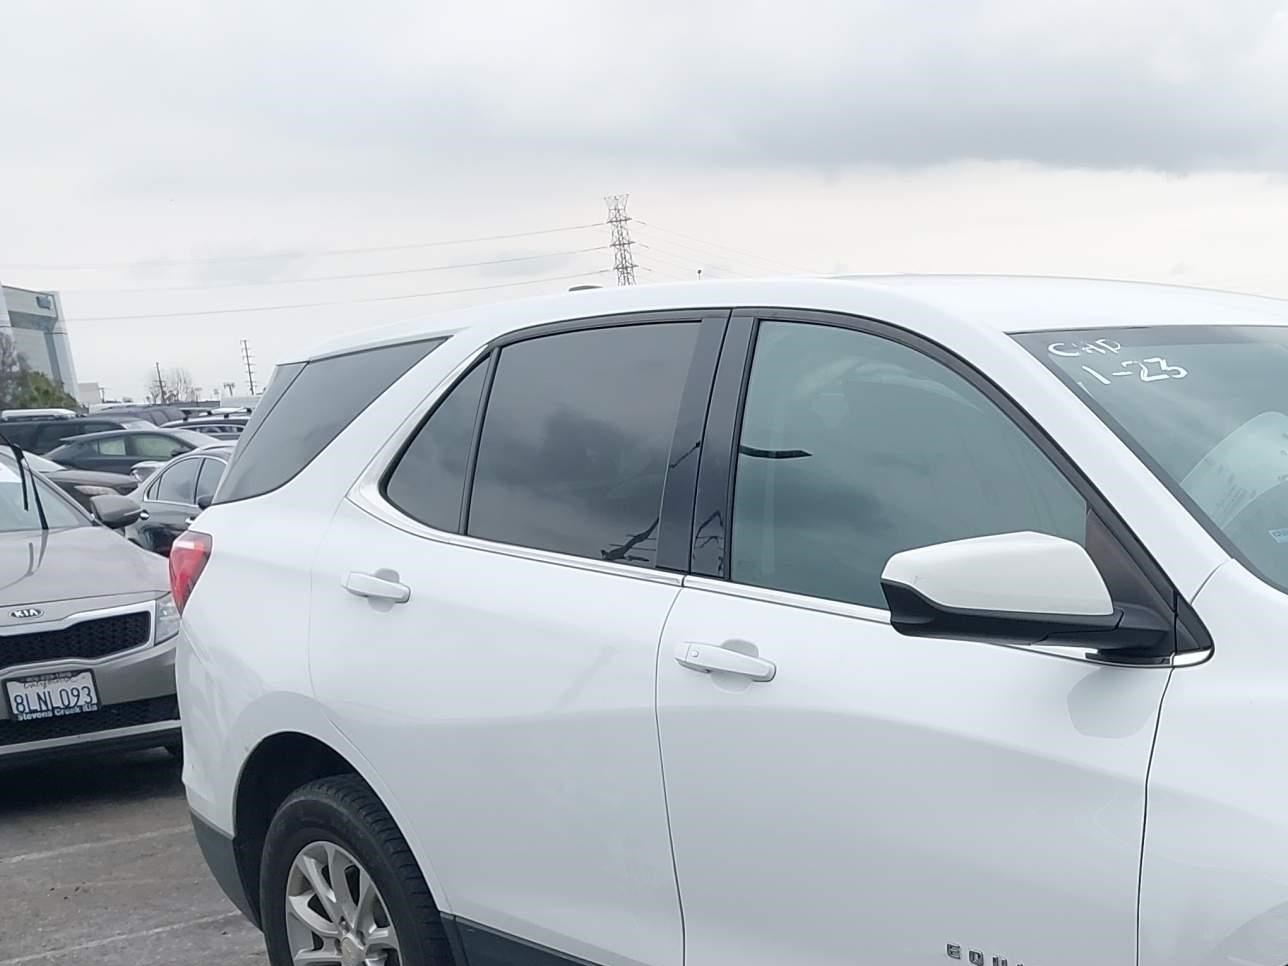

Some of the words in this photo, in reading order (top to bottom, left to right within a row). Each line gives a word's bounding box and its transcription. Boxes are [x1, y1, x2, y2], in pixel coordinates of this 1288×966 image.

[1082, 357, 1188, 385] 1-23
[15, 609, 40, 618] KIA
[14, 686, 93, 714] 8LNL093
